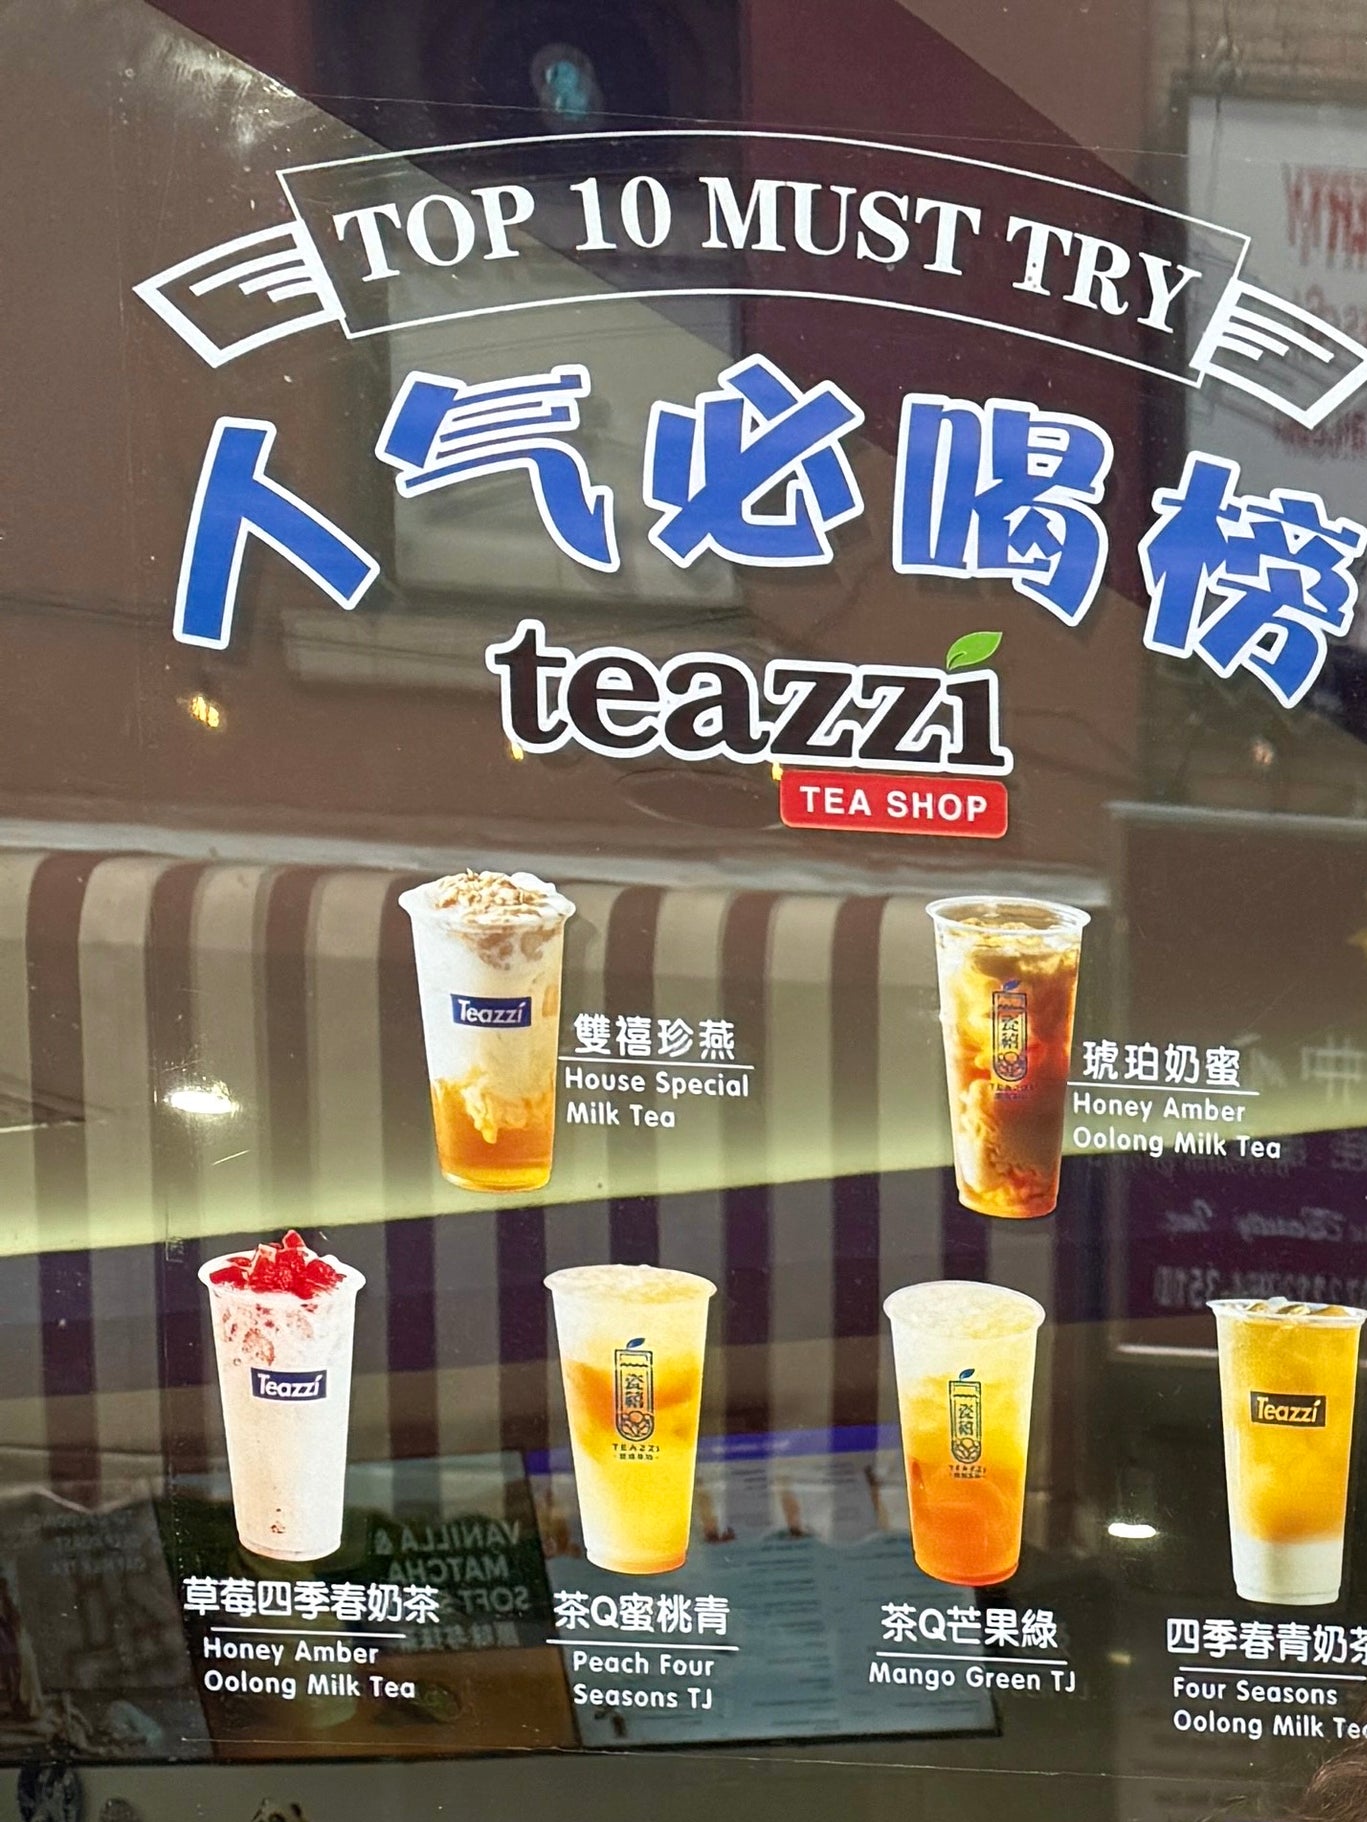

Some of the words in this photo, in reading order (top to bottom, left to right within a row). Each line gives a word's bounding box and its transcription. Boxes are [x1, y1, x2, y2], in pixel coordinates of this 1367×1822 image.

[332, 185, 535, 282] TOP
[570, 176, 671, 251] 10
[700, 177, 981, 275] MUST
[1007, 215, 1202, 334] TRY
[488, 621, 1011, 775] teazzi
[800, 789, 876, 818] TEA
[887, 791, 988, 822] SHOP
[458, 999, 526, 1024] Teazzi
[573, 1013, 735, 1060] 雙禧珍燕
[1082, 1039, 1241, 1088] 琥珀奶蜜
[565, 1067, 645, 1092] House
[656, 1071, 749, 1099] Special
[566, 1102, 619, 1125] Milk
[629, 1104, 675, 1128] Tea
[1073, 1092, 1152, 1122] Honey
[1163, 1097, 1245, 1122] Amber
[1073, 1127, 1163, 1158] Oolong
[1175, 1132, 1226, 1157] Milk
[1236, 1136, 1281, 1159] Tea
[258, 1373, 323, 1397] Teazzi
[1257, 1396, 1321, 1422] Teazzi
[182, 1576, 440, 1624] 草莓四季春奶茶
[553, 1590, 730, 1635] 茶Q蜜桃青
[881, 1602, 1058, 1648] 茶Q芒果綠
[203, 1637, 284, 1666] Honey
[295, 1640, 379, 1664] Amber
[573, 1651, 649, 1674] Peach
[660, 1654, 715, 1676] Four
[204, 1670, 296, 1699] Oolong
[307, 1674, 360, 1696] Milk
[369, 1676, 415, 1698] Tea
[869, 1662, 955, 1691] Mango
[966, 1666, 1041, 1691] Green
[1050, 1671, 1076, 1692] TJ
[1173, 1677, 1226, 1699] Four
[1236, 1680, 1338, 1705] Seasons
[573, 1683, 678, 1708] Seasons
[687, 1687, 712, 1709] TJ
[1173, 1710, 1262, 1740] Oolong
[1273, 1715, 1324, 1737] Milk
